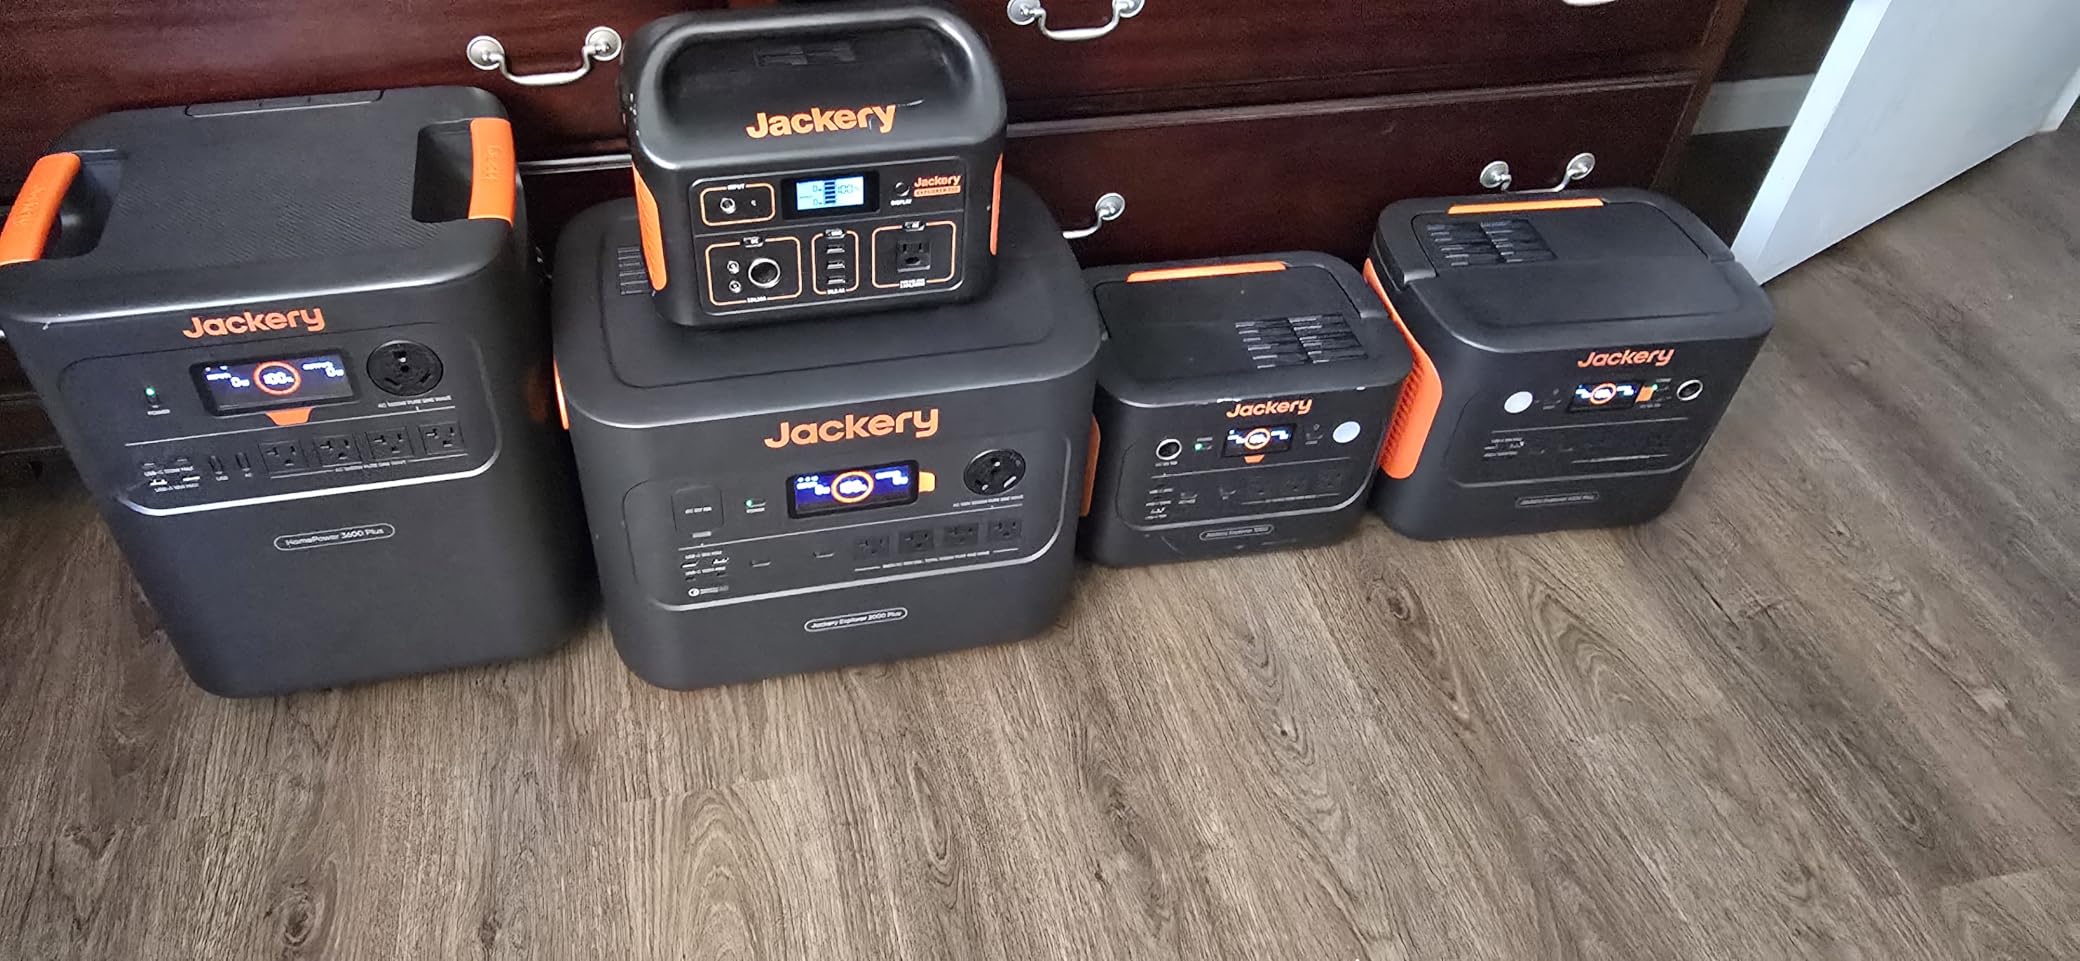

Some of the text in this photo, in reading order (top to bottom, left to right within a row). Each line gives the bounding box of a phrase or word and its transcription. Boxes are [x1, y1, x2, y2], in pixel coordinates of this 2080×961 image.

[745, 104, 897, 139] Jackery
[914, 175, 961, 188] Jackery
[182, 307, 326, 339] Jackery
[1577, 348, 1676, 368] Jackery
[1226, 399, 1313, 418] Jackery
[763, 408, 939, 449] Jackery
